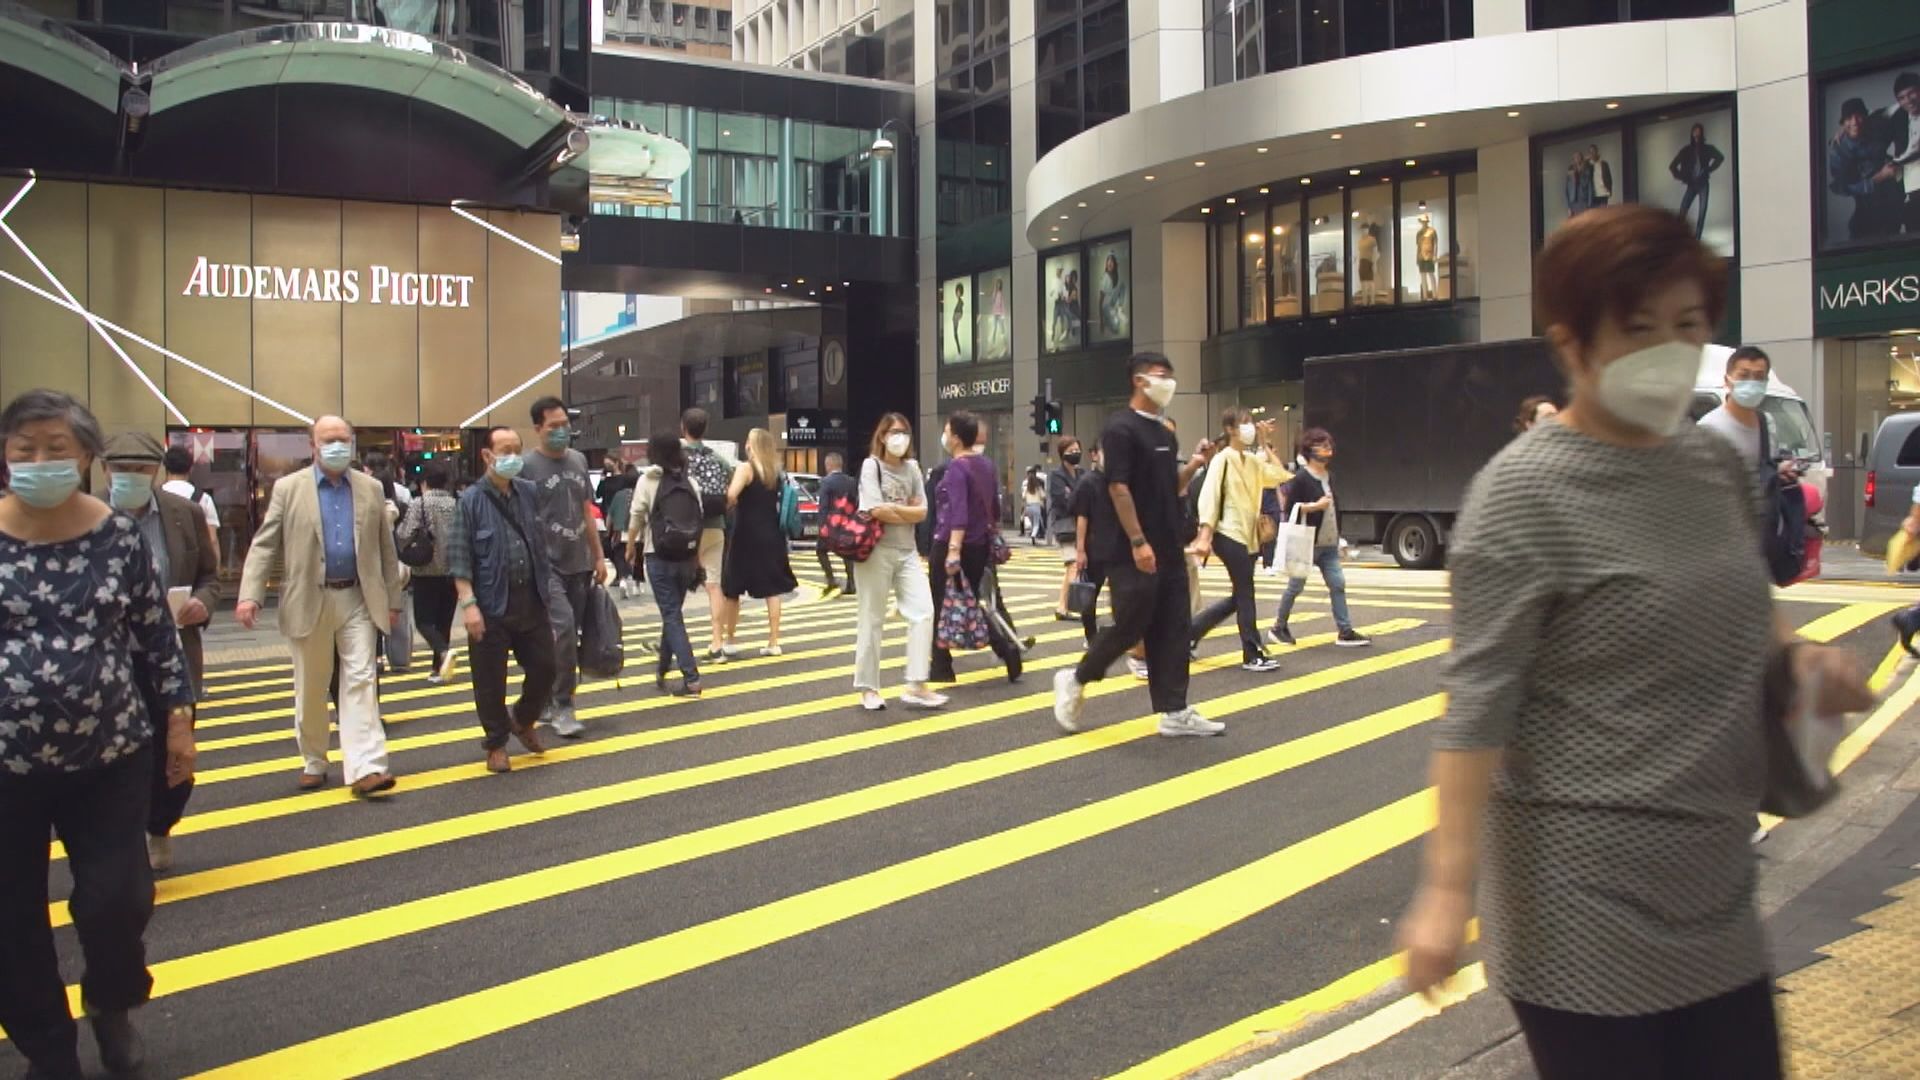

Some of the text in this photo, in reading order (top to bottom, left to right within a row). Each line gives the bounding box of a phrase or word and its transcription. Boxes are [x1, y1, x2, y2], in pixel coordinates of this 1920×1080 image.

[182, 255, 474, 308] AUDEMARS PIGUET
[1820, 275, 1920, 310] MARKS
[938, 383, 966, 400] MARKS
